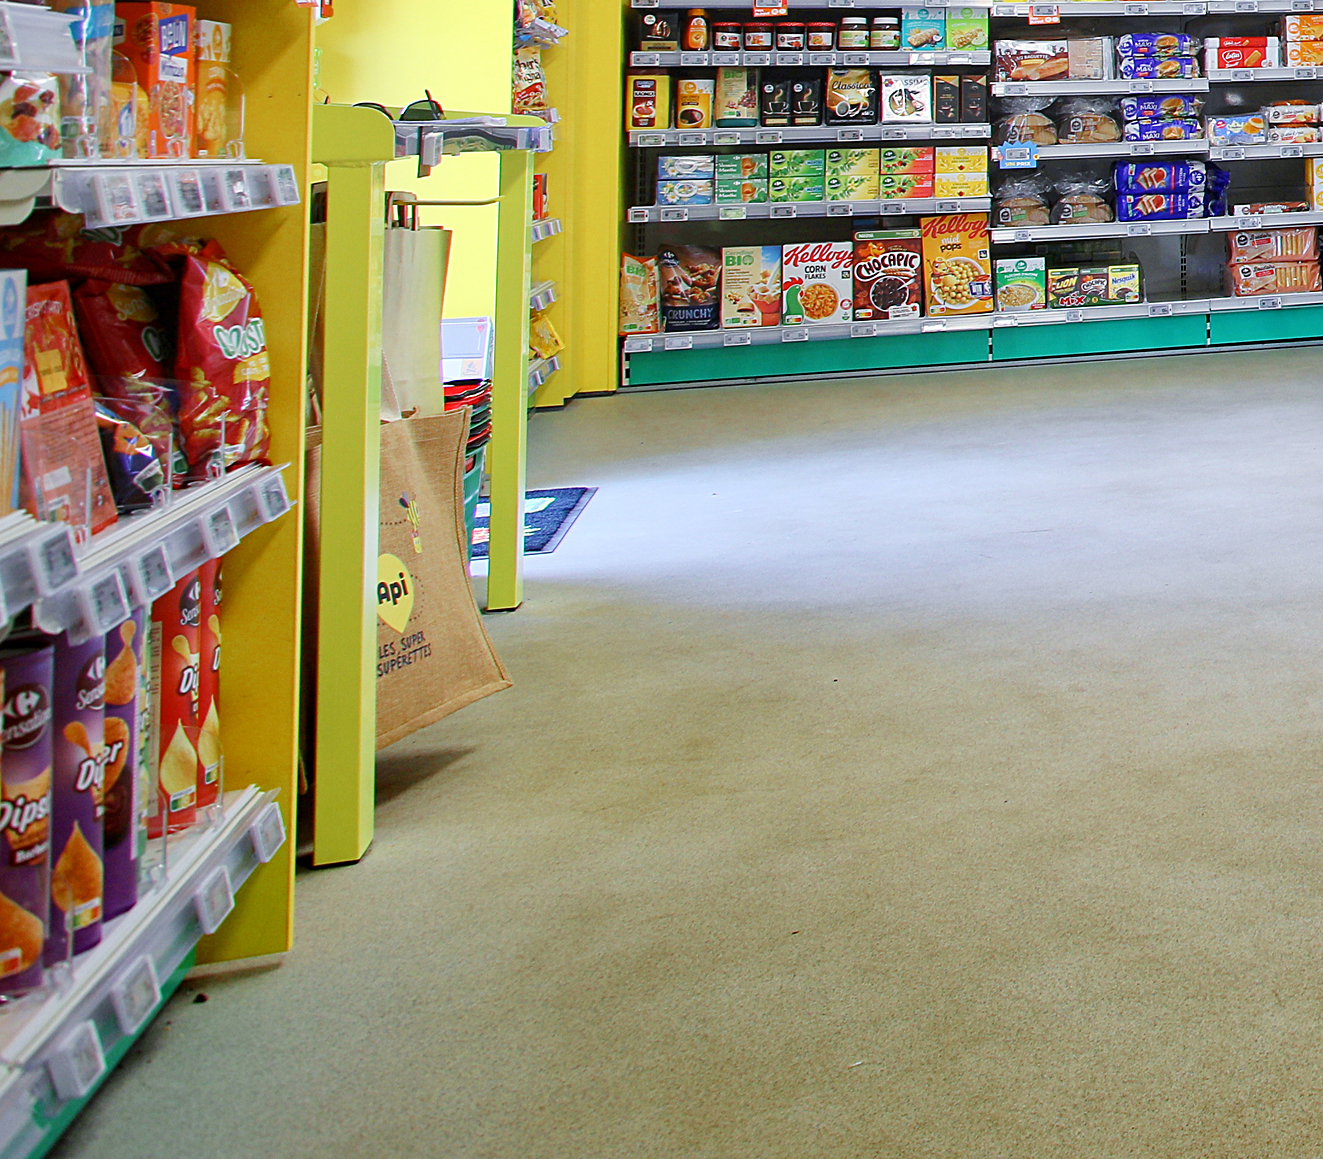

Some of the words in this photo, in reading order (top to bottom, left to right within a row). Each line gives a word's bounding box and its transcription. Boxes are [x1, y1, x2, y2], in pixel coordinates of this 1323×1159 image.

[941, 236, 960, 244] miel
[940, 243, 962, 253] pops
[725, 255, 754, 267] BIO
[855, 253, 919, 279] CHOCAPIC
[626, 265, 646, 277] BIO
[805, 265, 827, 274] CORN
[1111, 276, 1137, 286] Nesquik
[668, 308, 713, 320] CRUNCHY
[377, 571, 409, 606] Api
[379, 642, 395, 659] LES
[400, 631, 426, 651] SUPER
